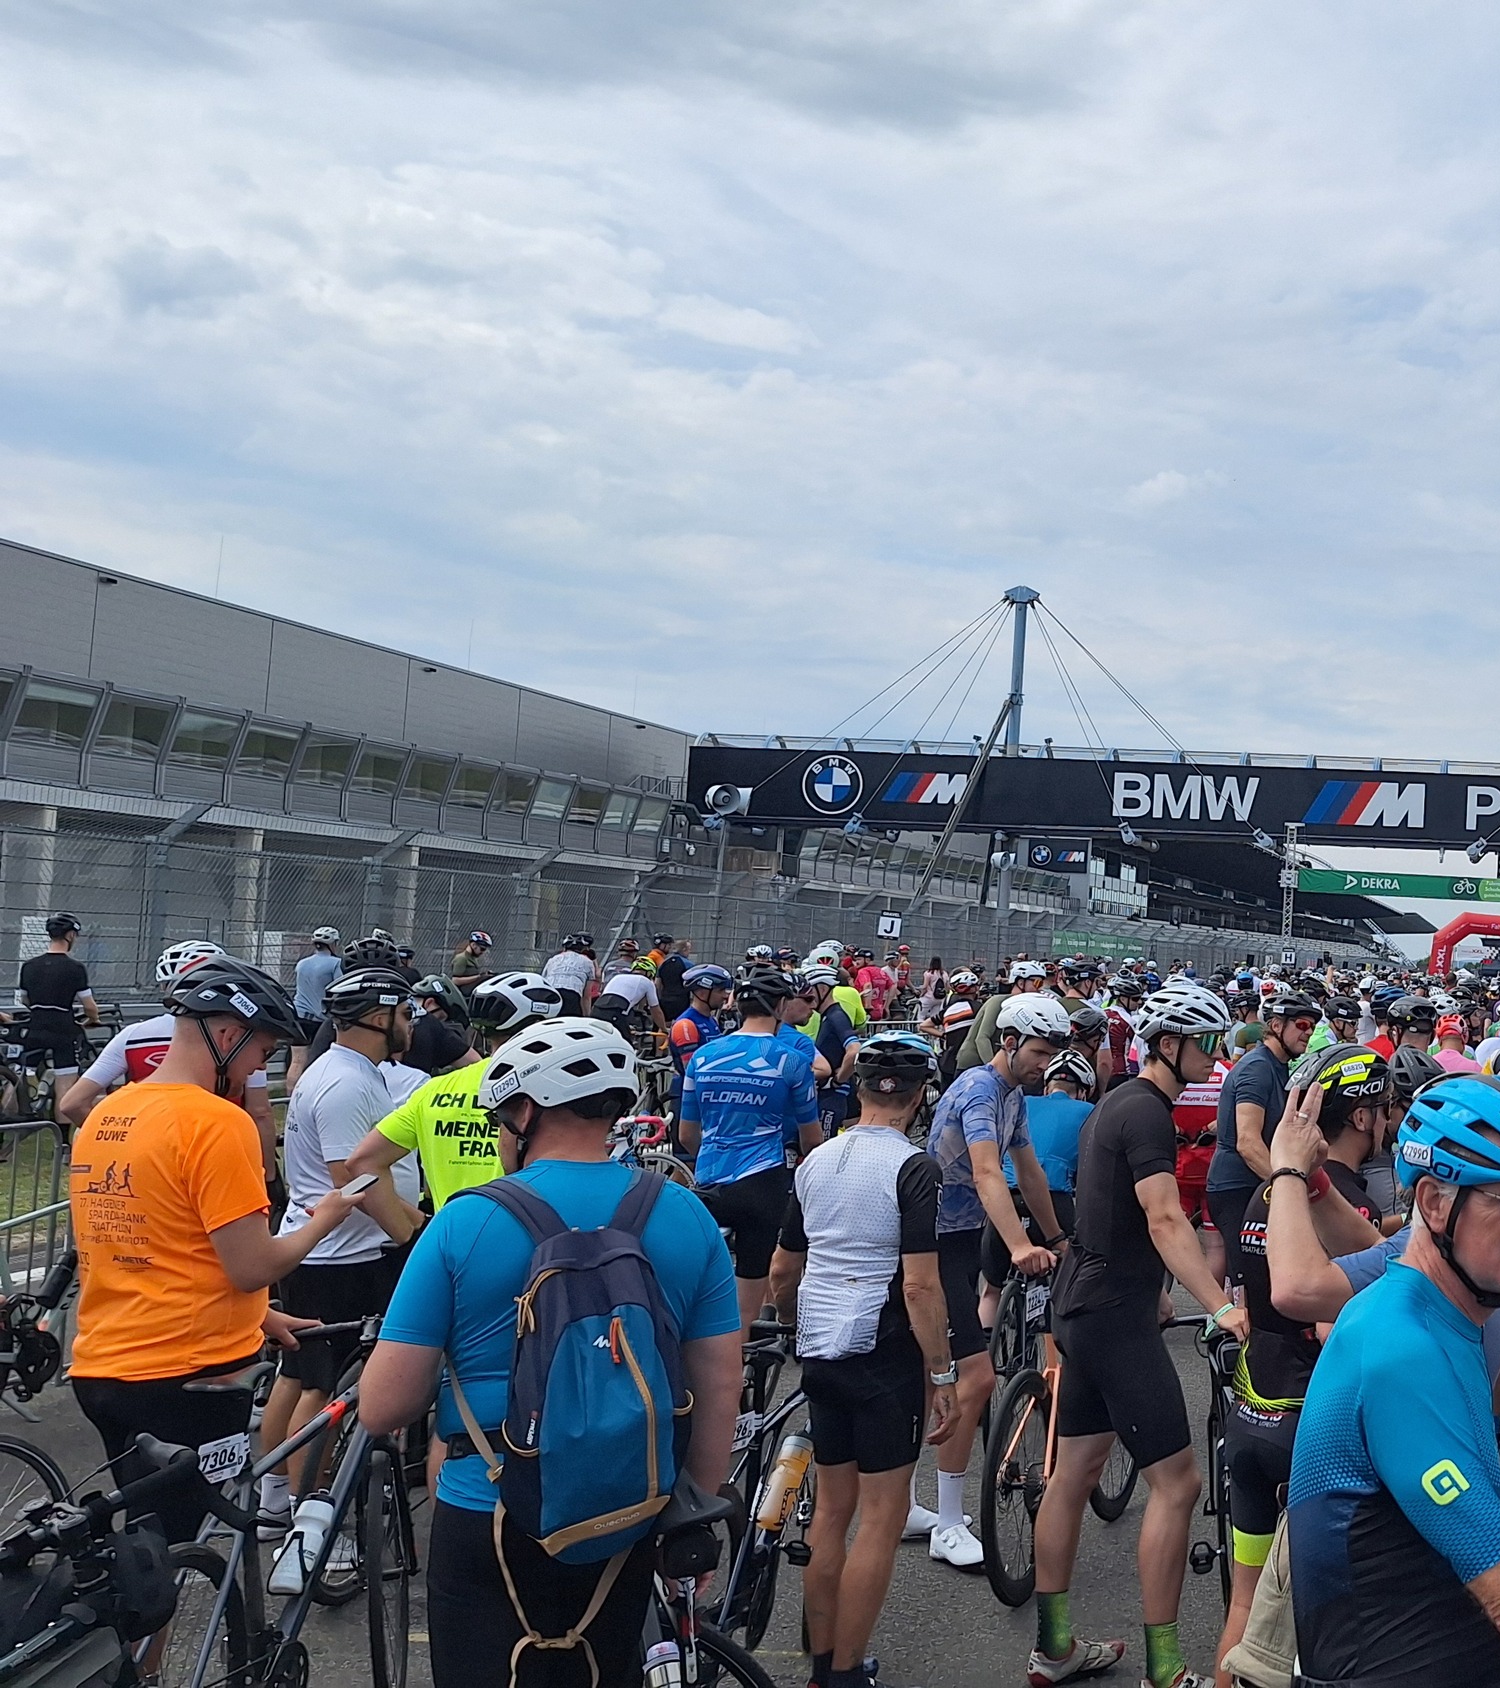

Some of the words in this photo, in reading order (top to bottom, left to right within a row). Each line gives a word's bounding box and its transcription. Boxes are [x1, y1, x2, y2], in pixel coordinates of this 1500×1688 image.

[811, 758, 856, 775] BMW
[1112, 771, 1260, 822] BMW
[1361, 877, 1401, 891] DEKRA
[883, 919, 895, 934] J
[1284, 953, 1293, 963] H
[521, 1065, 541, 1077] ABUS
[430, 1093, 467, 1109] ICH
[701, 1091, 768, 1106] FLORIAN
[95, 1130, 128, 1143] DUWE
[434, 1121, 500, 1139] MEINE
[458, 1141, 498, 1158] FRA
[200, 1447, 236, 1471] 7306
[593, 1510, 641, 1531] Quechua
